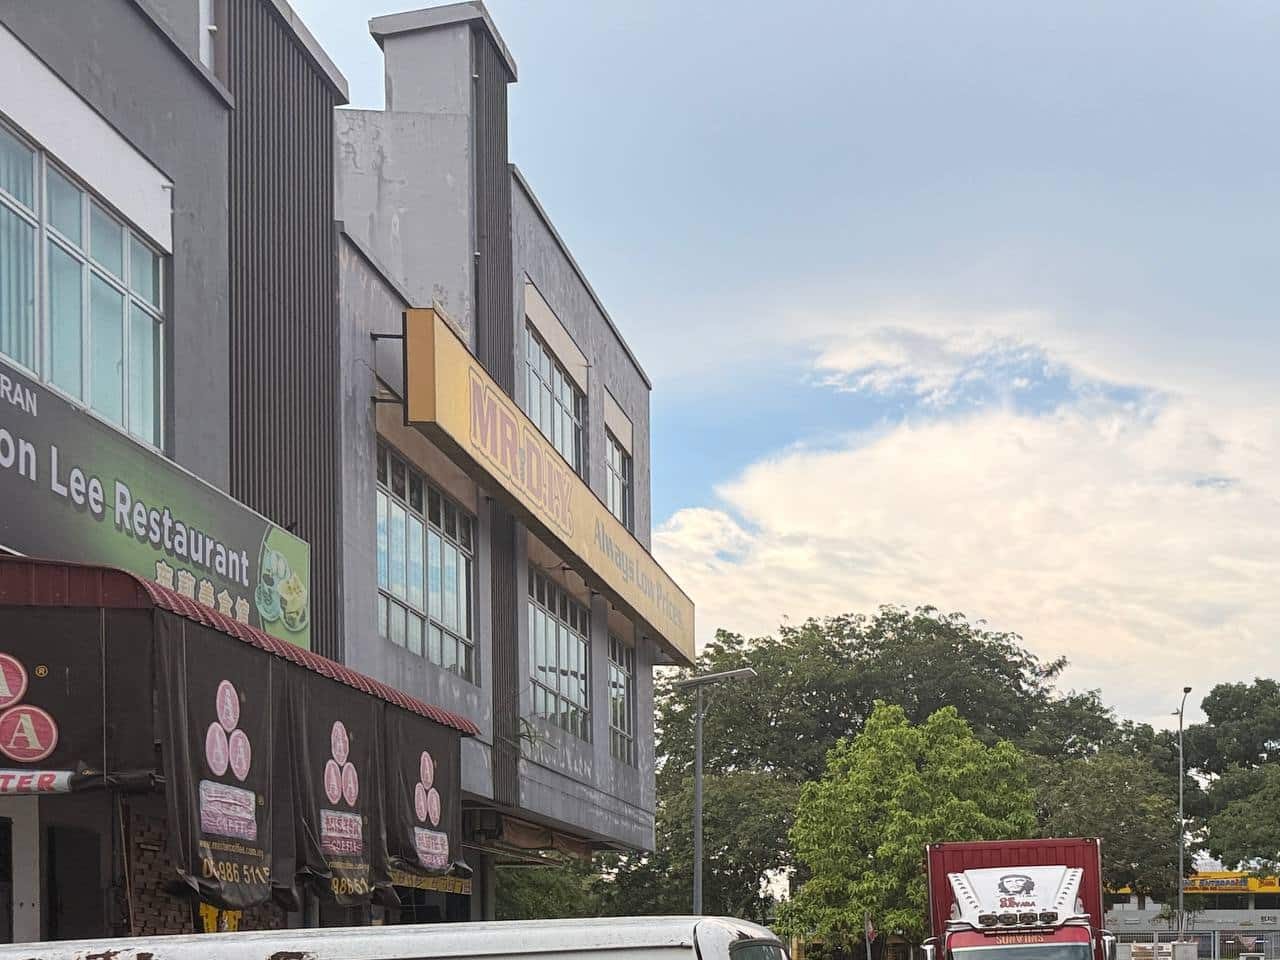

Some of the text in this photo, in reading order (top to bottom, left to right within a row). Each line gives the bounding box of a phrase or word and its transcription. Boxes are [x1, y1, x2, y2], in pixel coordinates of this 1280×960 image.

[51, 446, 104, 514] Lee
[115, 481, 249, 587] Restaurant
[6, 713, 45, 751] A
